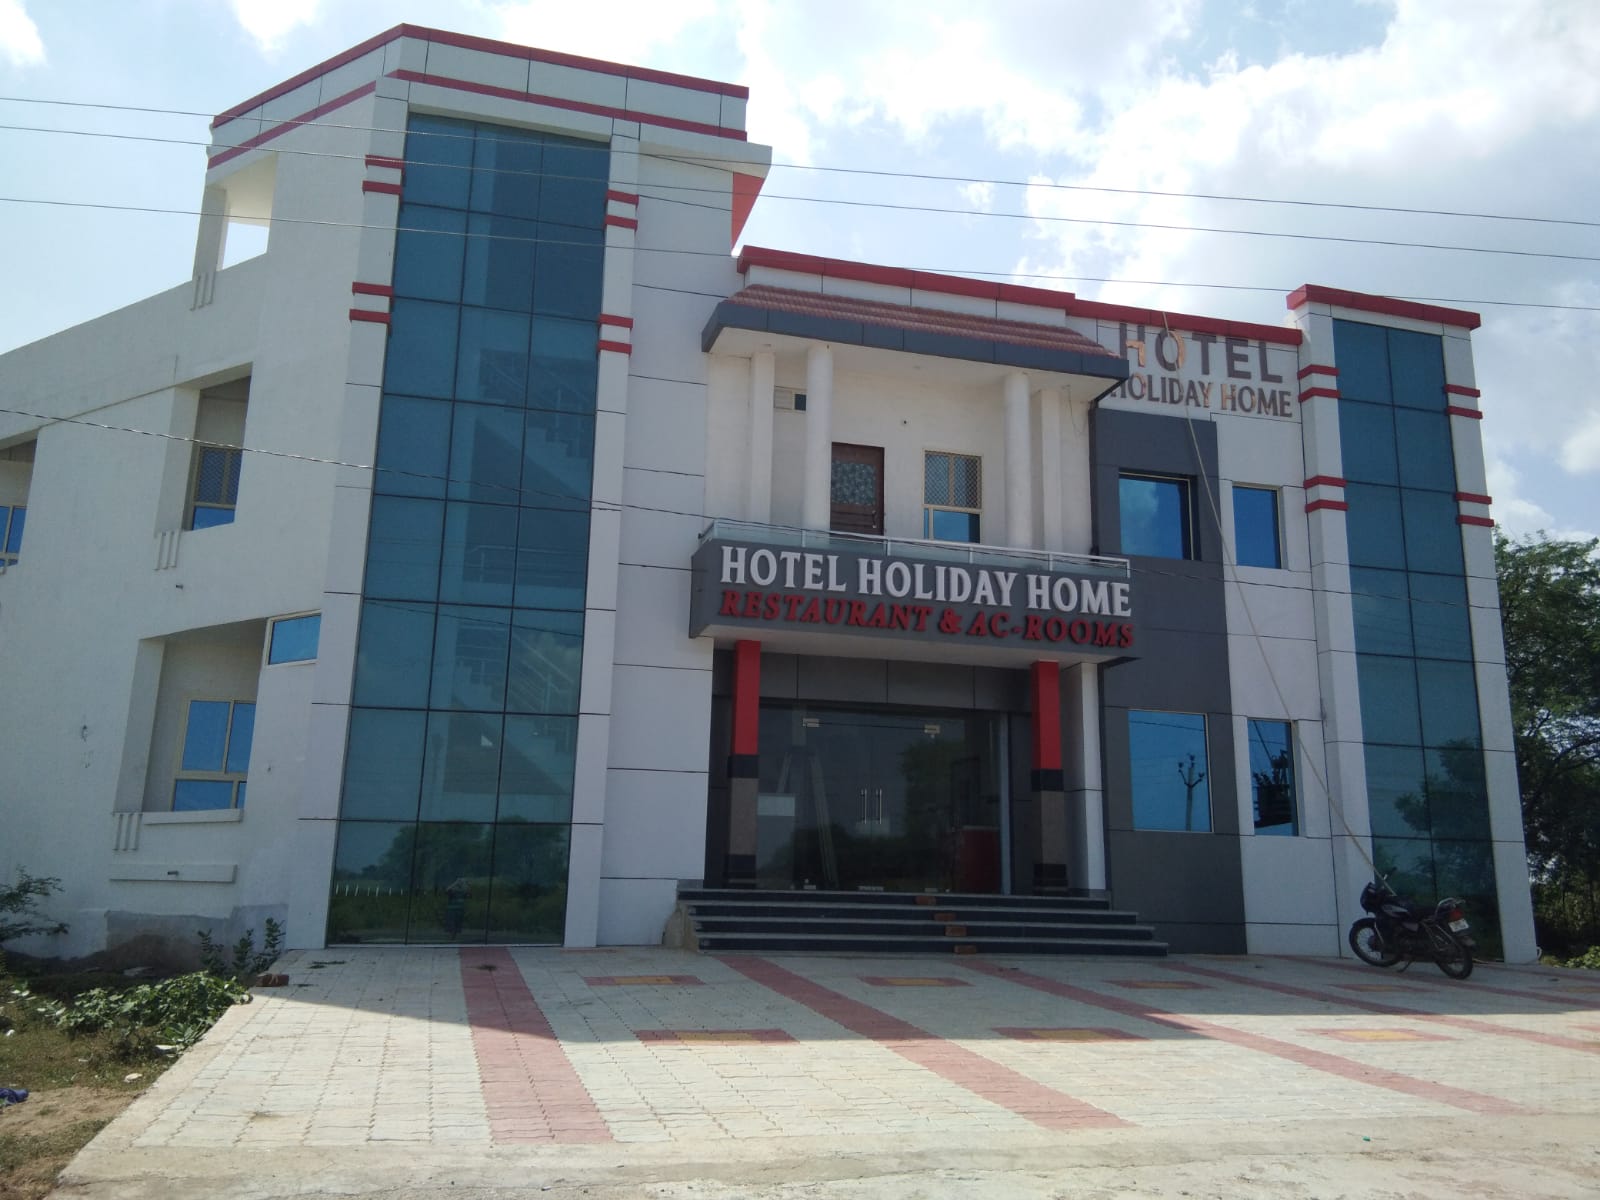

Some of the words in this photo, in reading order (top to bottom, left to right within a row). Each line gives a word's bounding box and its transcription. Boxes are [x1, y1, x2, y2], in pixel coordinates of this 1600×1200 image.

[1119, 323, 1282, 383] HOTEL
[1220, 383, 1293, 418] HOME
[720, 546, 846, 592] HOTEL
[857, 559, 1017, 607] HOLIDAY
[1025, 574, 1132, 617] HOME
[720, 591, 933, 631] RESTAURANT
[939, 608, 963, 635] &
[967, 611, 1135, 648] AC-ROOMS
